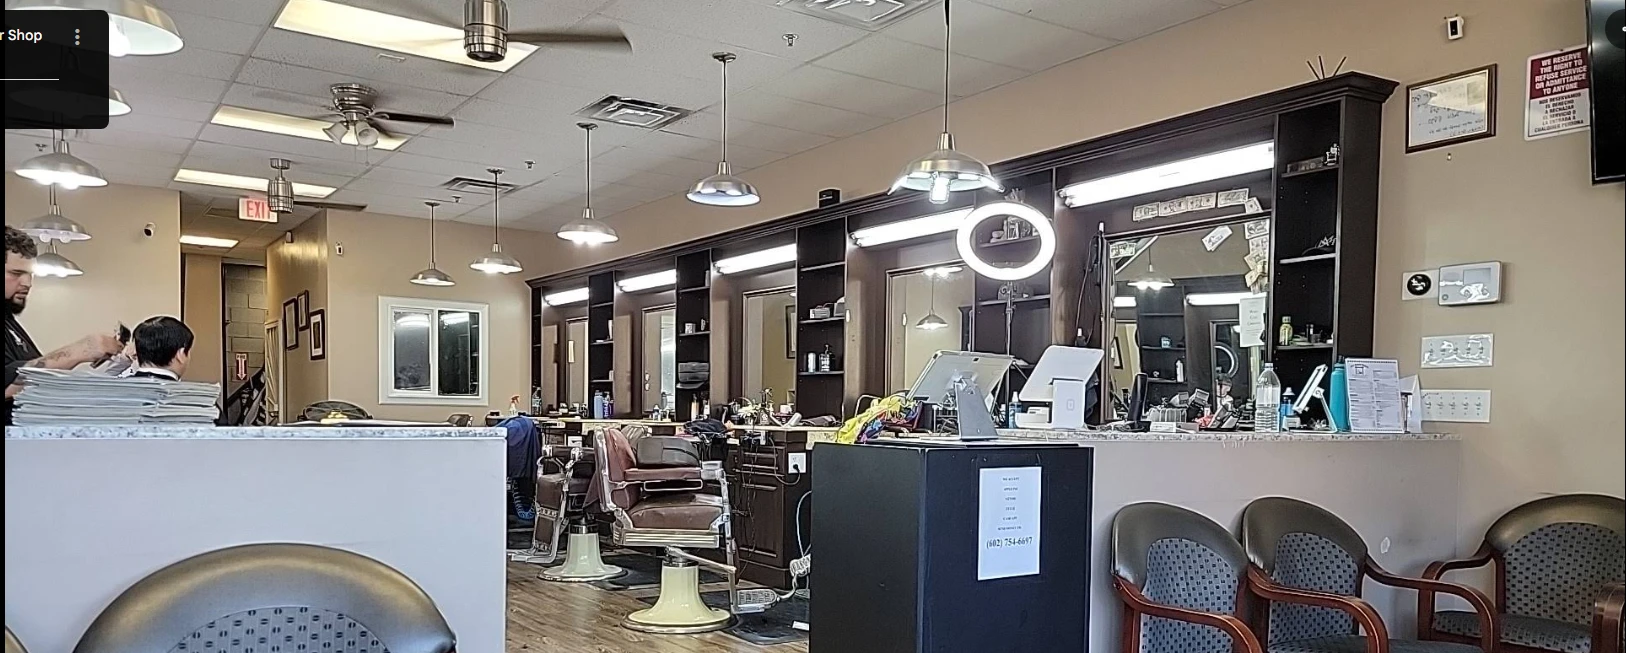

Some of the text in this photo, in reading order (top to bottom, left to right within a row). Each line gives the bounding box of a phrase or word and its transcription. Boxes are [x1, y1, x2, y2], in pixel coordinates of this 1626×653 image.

[1540, 59, 1583, 74] THE RIGHT TO
[1541, 52, 1582, 67] WE RESERVE
[1535, 65, 1588, 82] REFUSE SERVICE
[1545, 73, 1587, 87] ADMITTANCE
[1552, 82, 1579, 93] ANYONE
[986, 536, 1033, 549] (602) 754-6697
